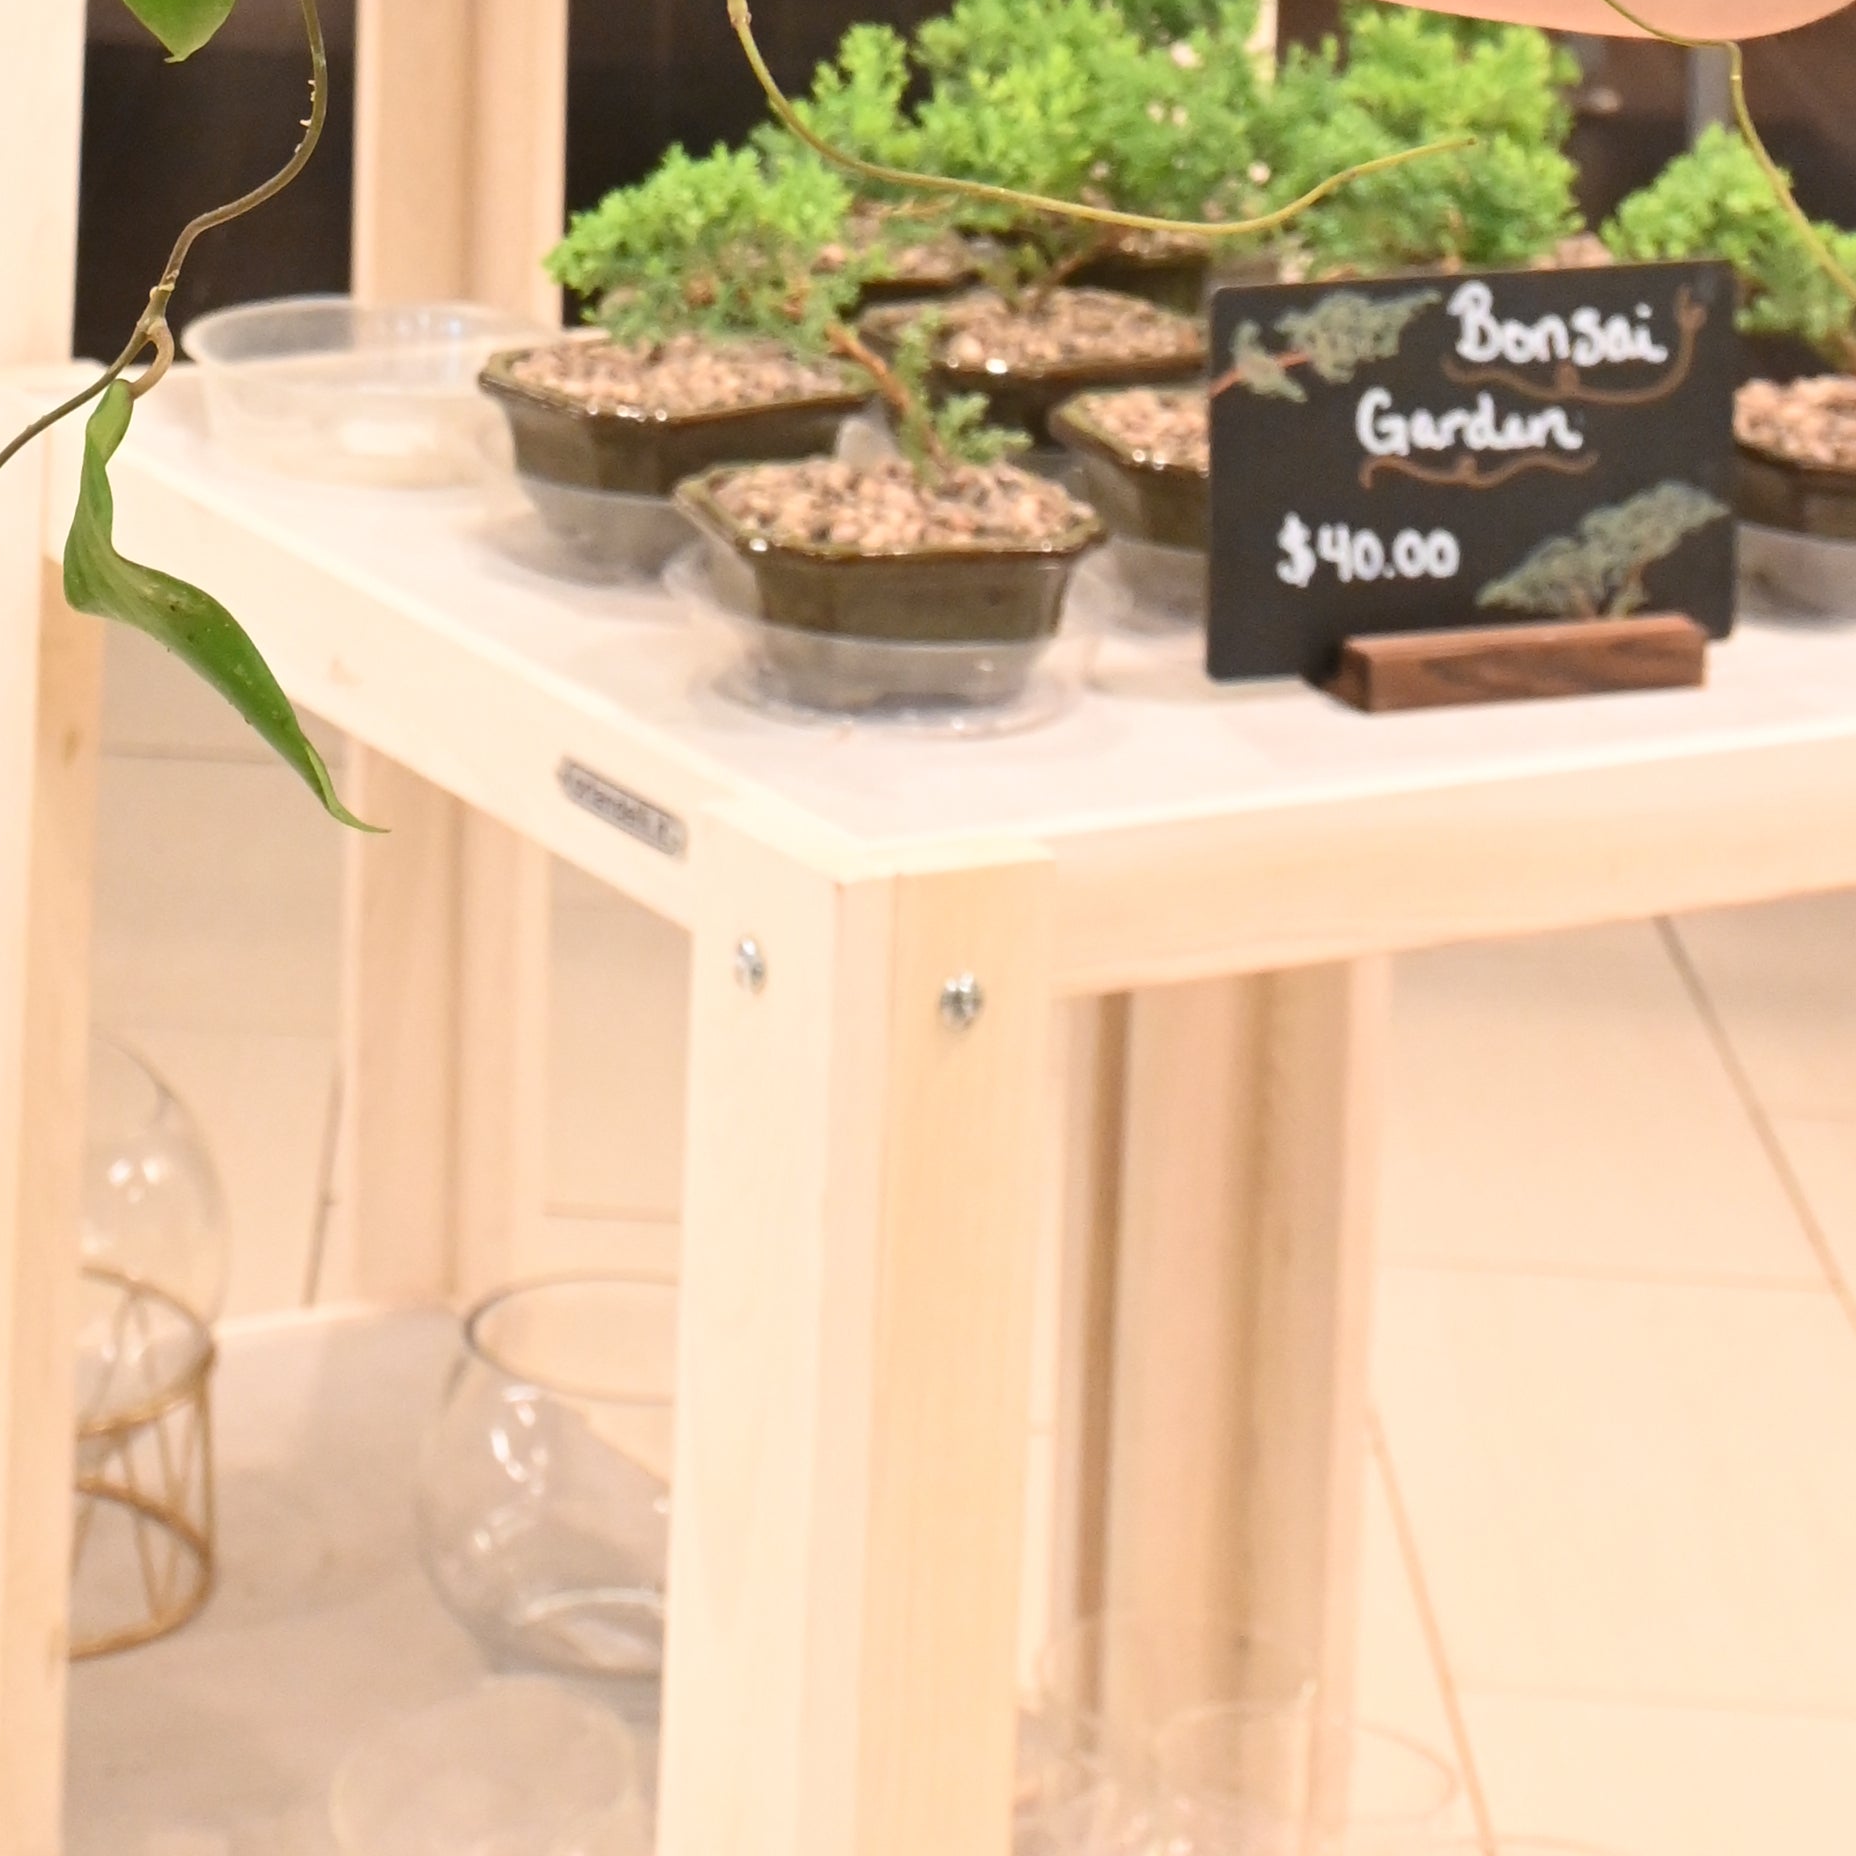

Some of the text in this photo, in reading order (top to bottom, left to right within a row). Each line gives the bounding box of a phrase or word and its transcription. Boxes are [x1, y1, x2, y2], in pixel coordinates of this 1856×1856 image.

[1447, 281, 1668, 366] Bonsai
[1356, 388, 1583, 456] Garden
[1277, 513, 1460, 587] $40.00
